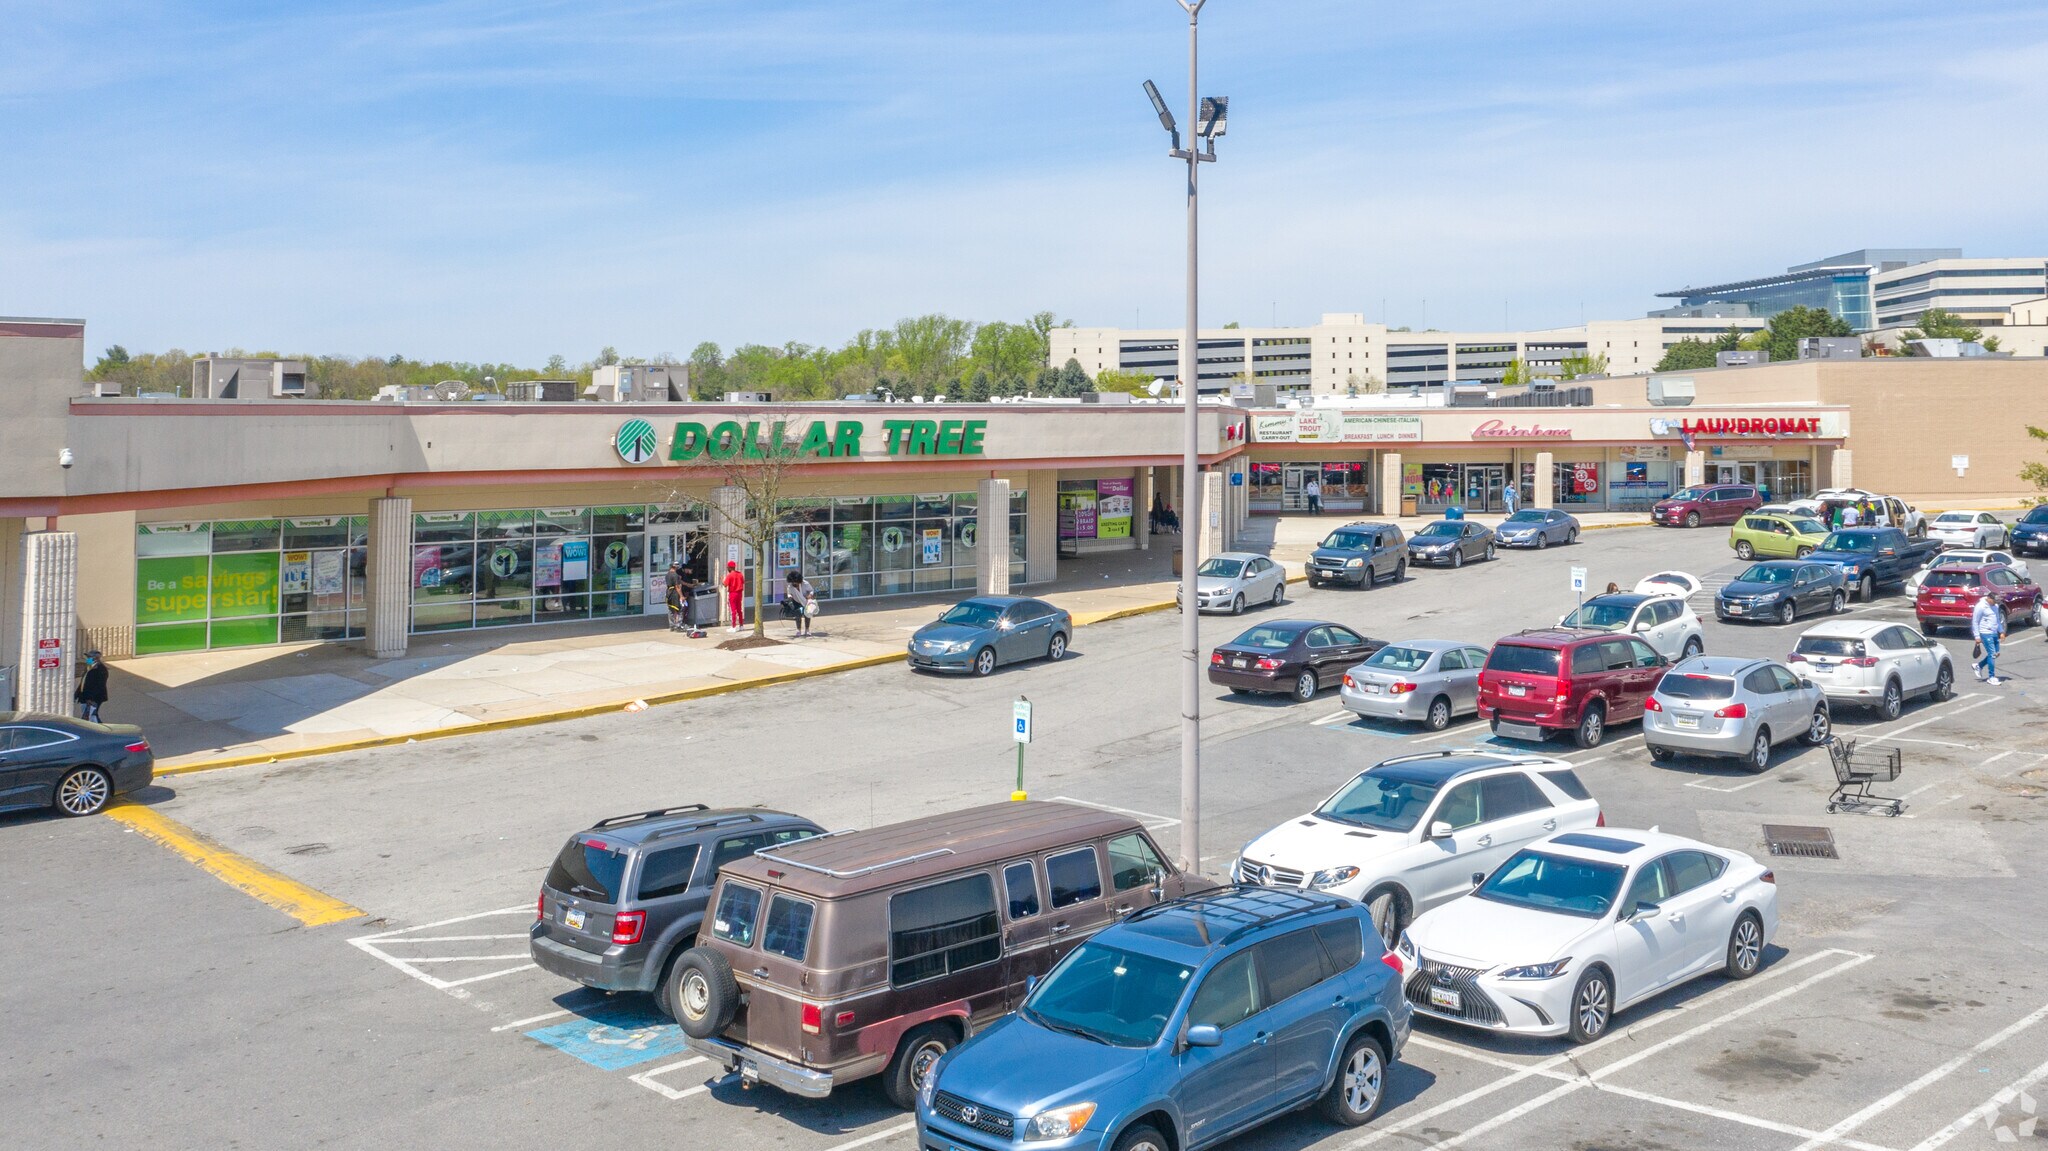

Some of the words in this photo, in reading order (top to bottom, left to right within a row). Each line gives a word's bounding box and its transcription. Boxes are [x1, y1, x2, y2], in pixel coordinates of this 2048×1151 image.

[1471, 419, 1573, 437] Rainbow
[1682, 418, 1821, 434] LAUNDROMAT
[668, 420, 864, 461] DOLLAR
[882, 419, 988, 456] TREE
[1575, 462, 1596, 470] SALE
[1584, 481, 1595, 489] 50
[286, 553, 308, 561] WOW!
[496, 554, 511, 576] $1
[609, 548, 625, 569] $1
[147, 580, 165, 590] Be
[168, 581, 177, 590] a
[182, 570, 267, 590] savings
[284, 566, 310, 583] ICE
[146, 585, 278, 615] superstar!
